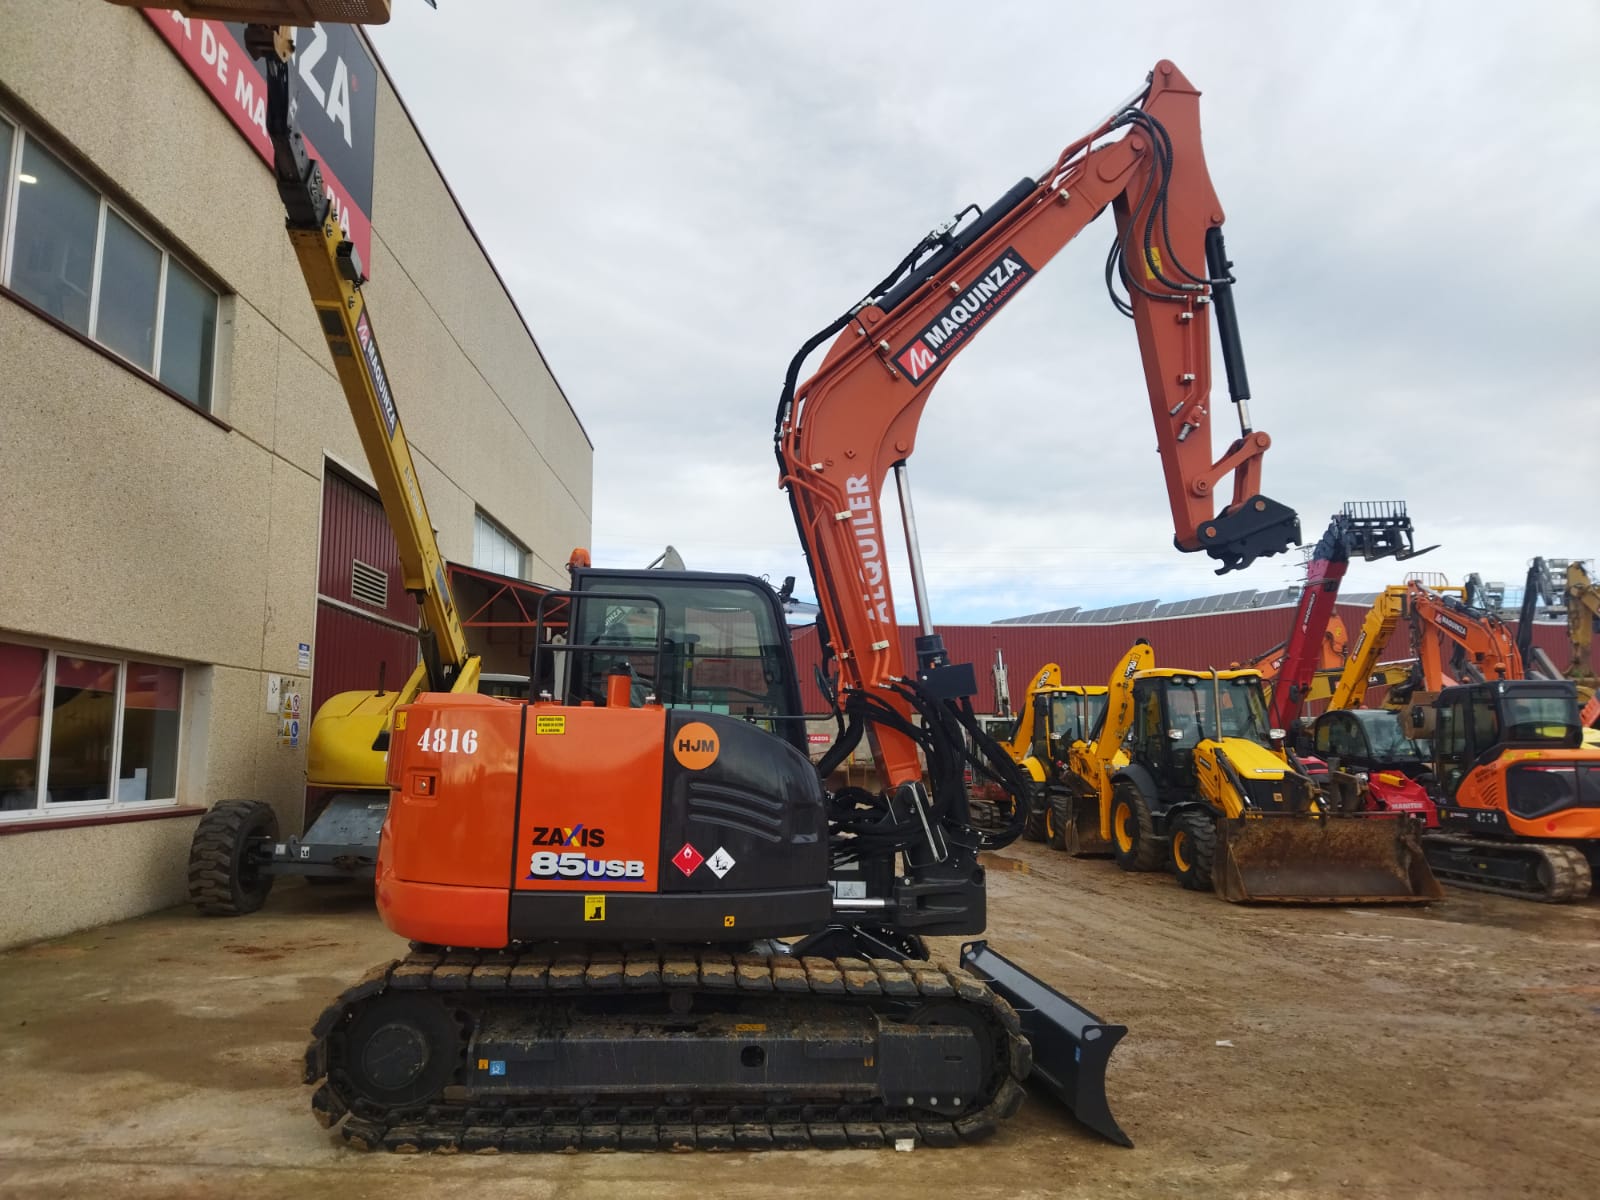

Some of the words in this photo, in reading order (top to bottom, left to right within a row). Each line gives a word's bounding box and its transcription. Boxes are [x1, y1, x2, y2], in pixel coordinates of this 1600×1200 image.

[201, 21, 229, 85] DE
[924, 257, 1022, 349] MAQUINZA
[940, 331, 964, 355] ALQUILER
[968, 310, 987, 327] VENTA
[985, 303, 994, 311] DE
[992, 271, 1027, 305] MAQUINARIA
[367, 339, 397, 431] MAQUINZA
[846, 473, 890, 624] ALQUILER
[417, 727, 478, 754] 4816
[678, 739, 715, 753] HJM
[532, 823, 605, 847] ZAXIS
